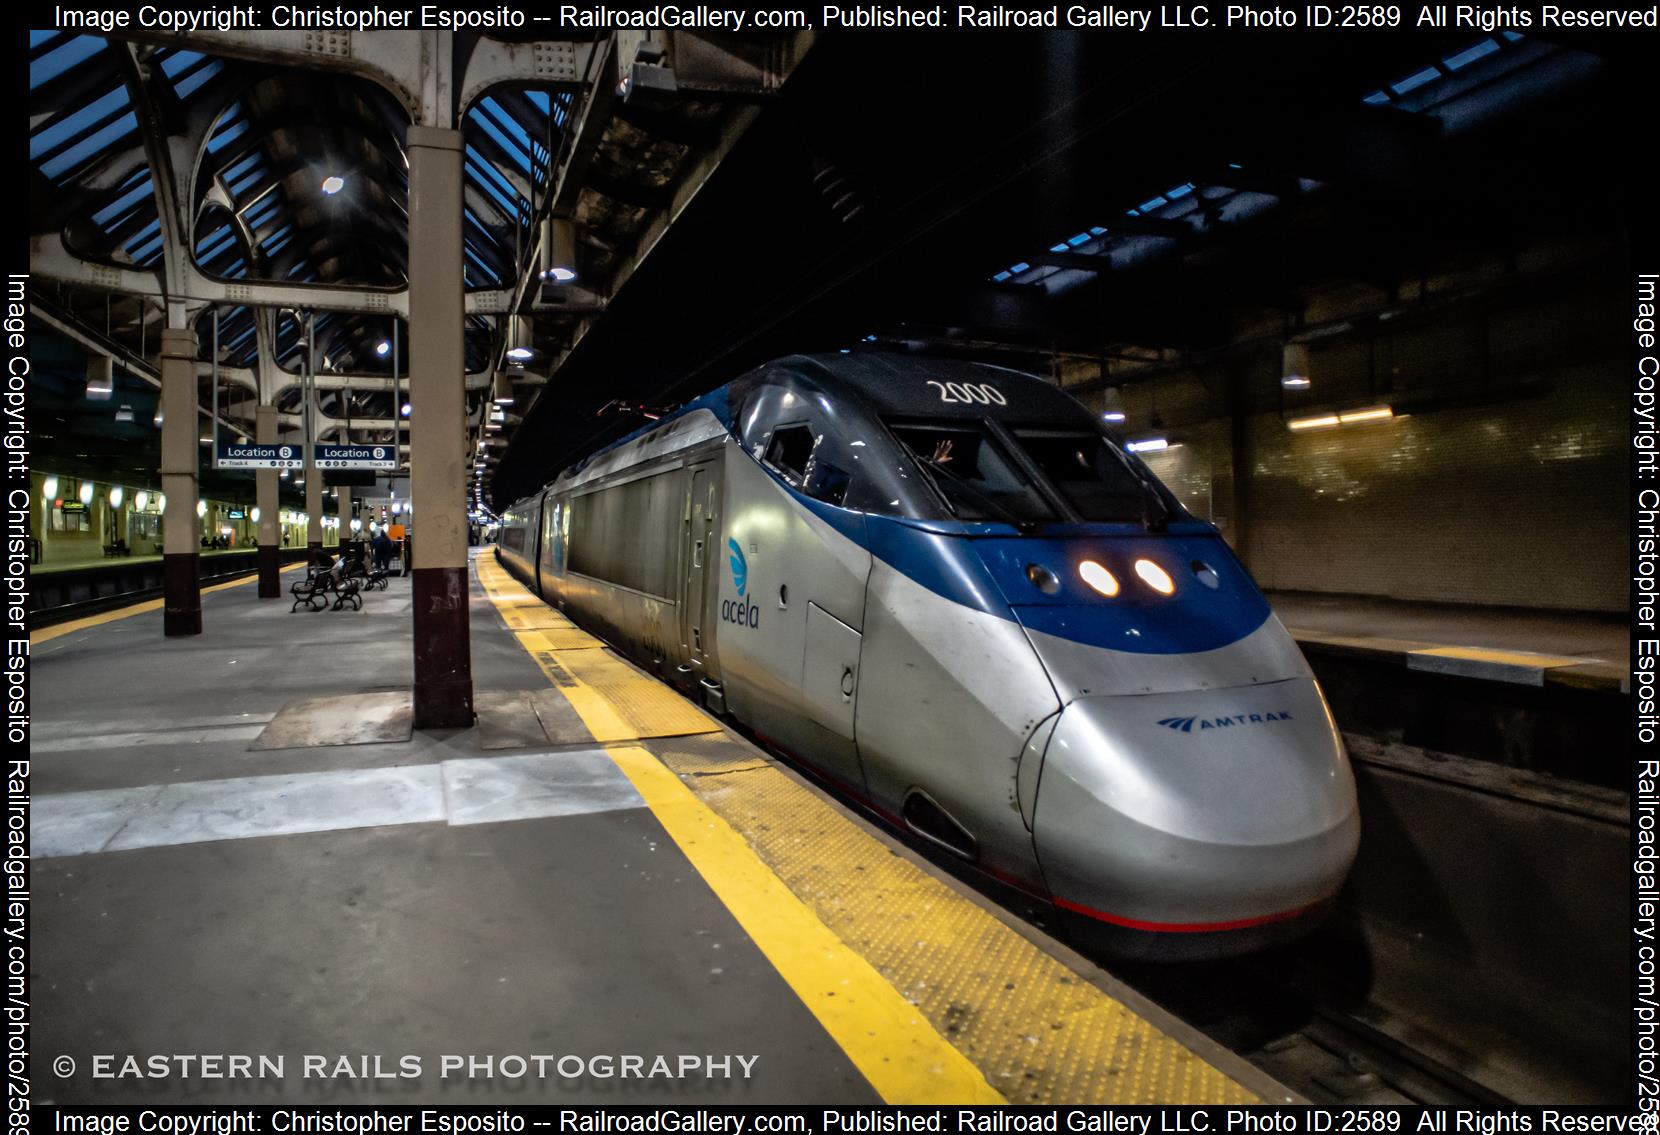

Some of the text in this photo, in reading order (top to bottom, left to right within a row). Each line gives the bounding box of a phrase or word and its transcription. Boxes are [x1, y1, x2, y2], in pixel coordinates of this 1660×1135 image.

[927, 381, 1006, 405] 2000
[228, 447, 275, 457] Location
[324, 448, 369, 457] Location
[722, 593, 759, 629] acela
[1201, 711, 1293, 729] AMTRAK
